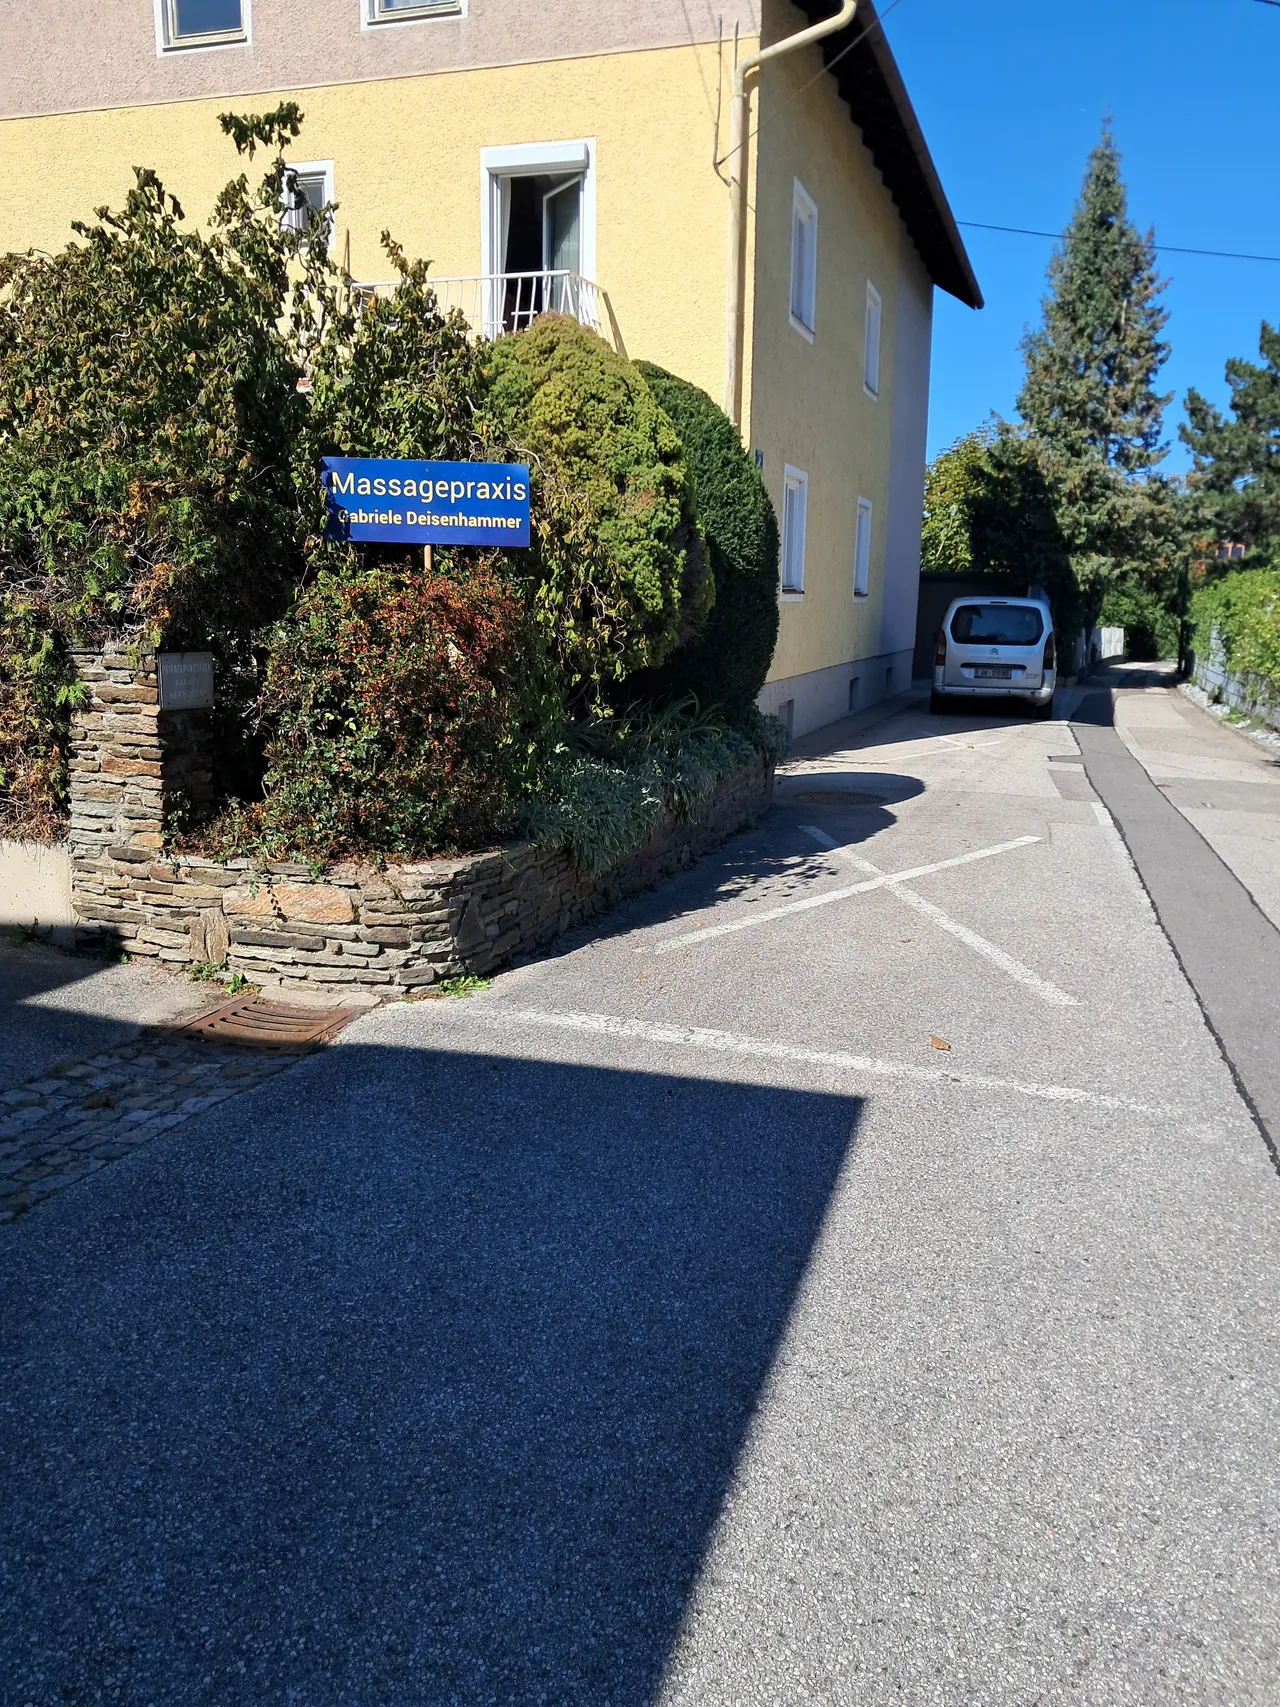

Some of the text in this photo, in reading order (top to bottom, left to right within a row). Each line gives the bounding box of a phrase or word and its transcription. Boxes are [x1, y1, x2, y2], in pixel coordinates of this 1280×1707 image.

[332, 471, 526, 503] Massagepraxis
[338, 509, 522, 529] Gabriele Deisenhammer
